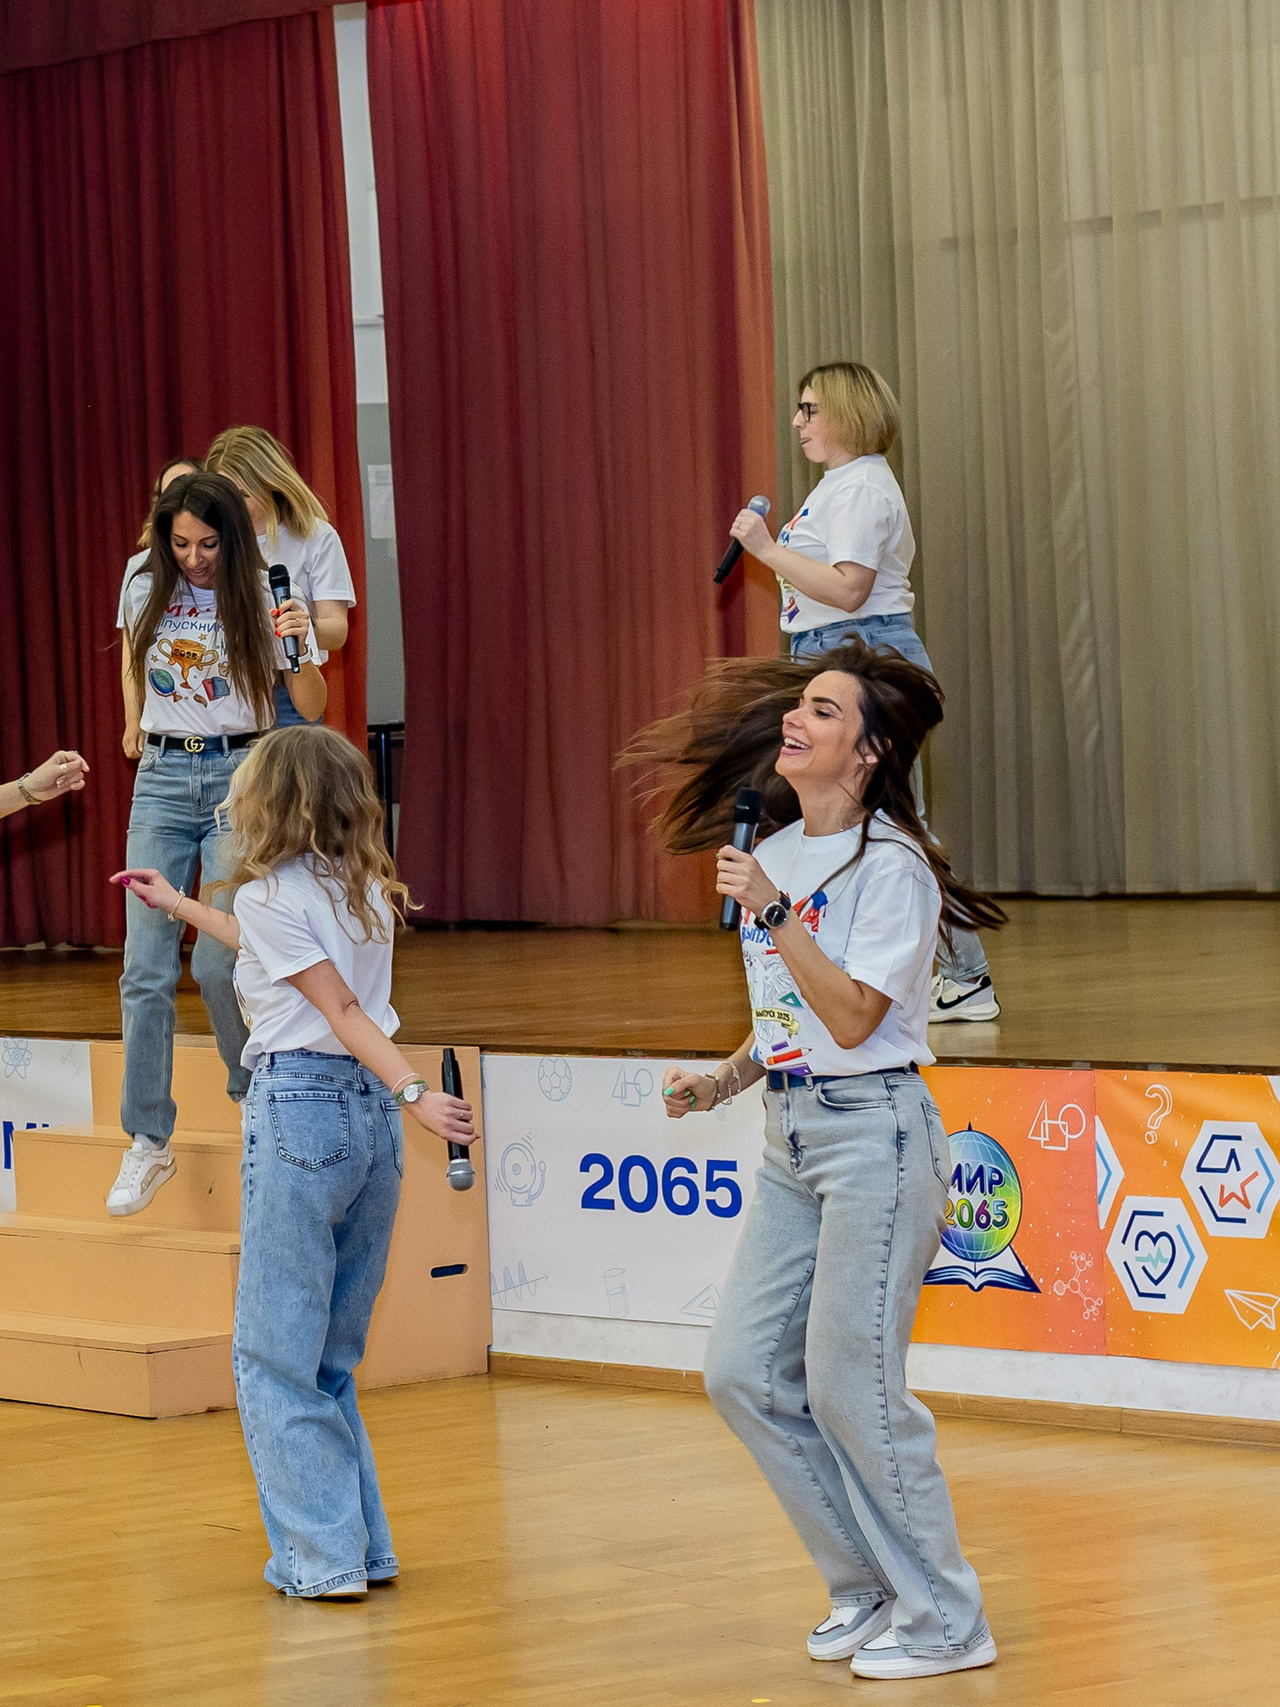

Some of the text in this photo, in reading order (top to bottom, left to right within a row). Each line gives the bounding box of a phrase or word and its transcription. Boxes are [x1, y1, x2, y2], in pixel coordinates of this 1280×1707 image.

[174, 648, 199, 661] 2025
[579, 1152, 743, 1219] 2065
[945, 1198, 1010, 1230] 2065
